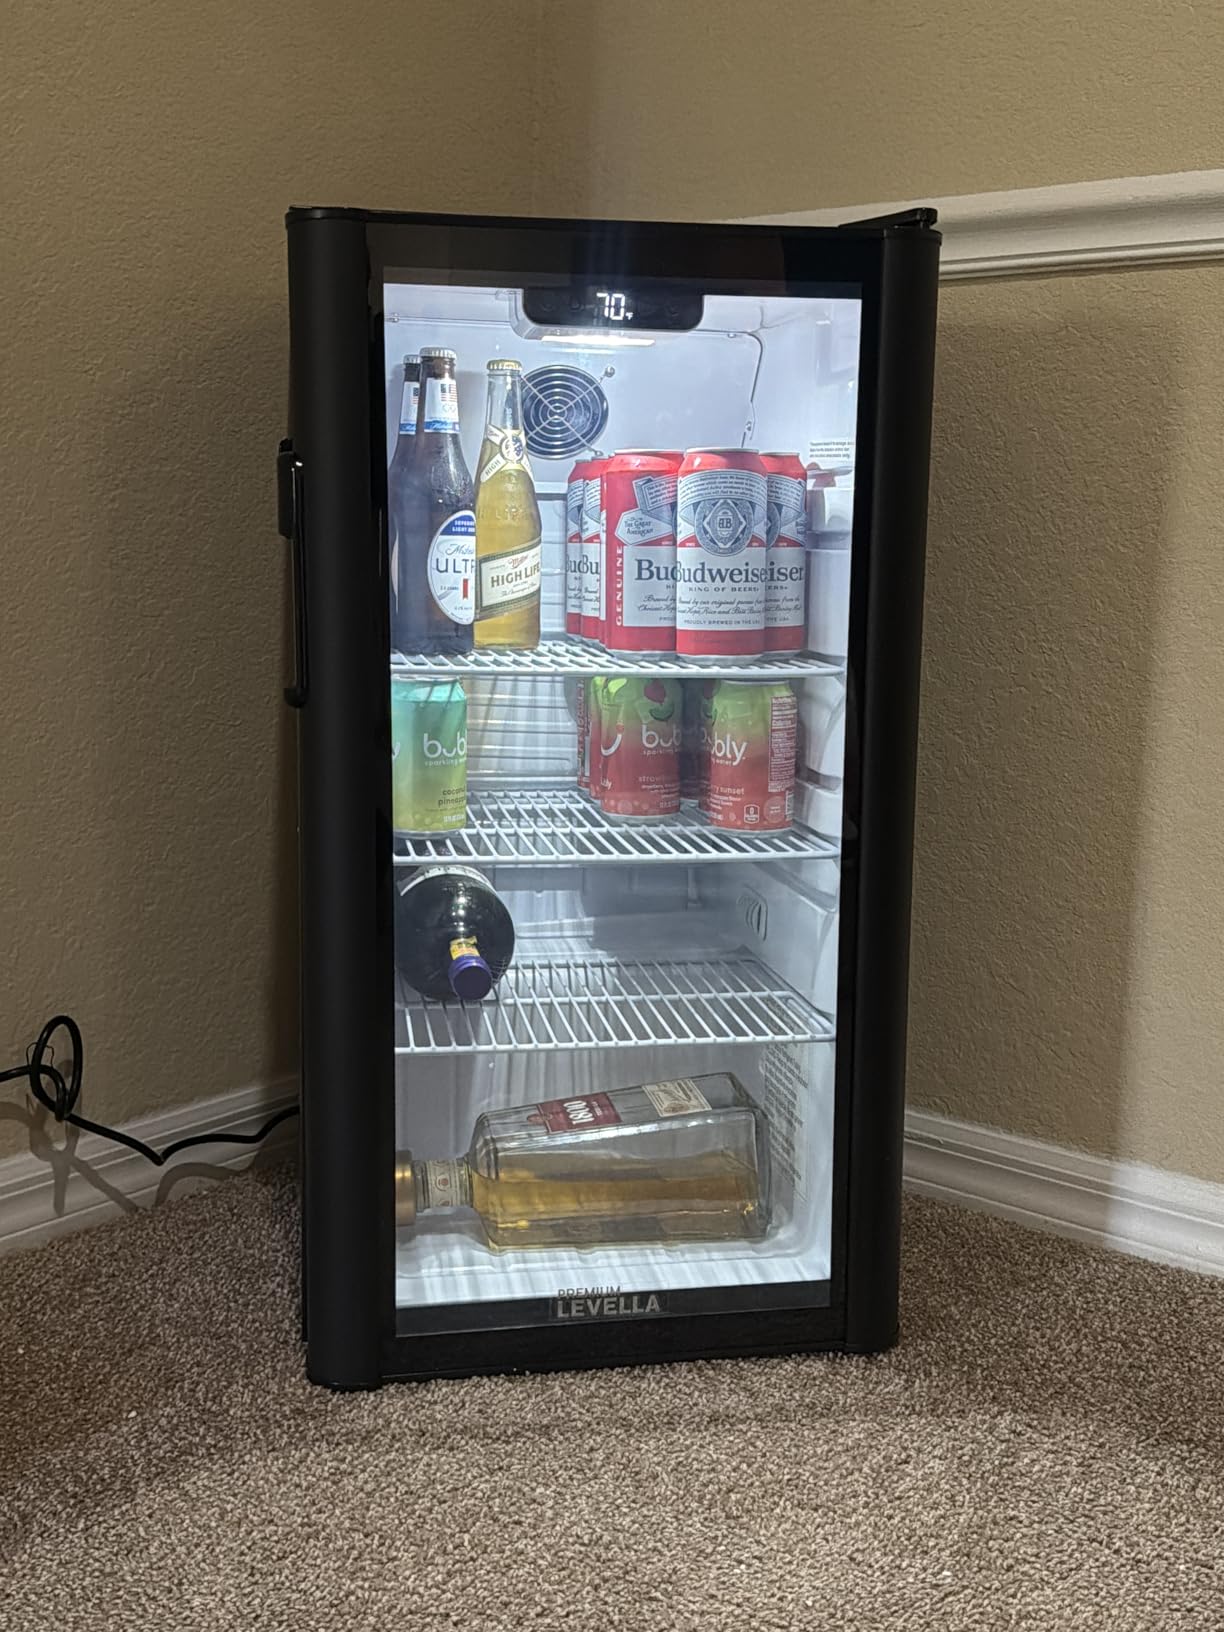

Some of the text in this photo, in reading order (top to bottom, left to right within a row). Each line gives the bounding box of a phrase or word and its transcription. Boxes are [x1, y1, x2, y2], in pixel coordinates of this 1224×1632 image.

[596, 293, 625, 320] 70
[485, 459, 502, 476] HIGH
[490, 570, 523, 588] HIGH
[524, 561, 541, 579] LIFE
[720, 786, 745, 796] sunset
[563, 1099, 595, 1126] 1800
[558, 1285, 621, 1299] PREMIUM
[557, 1294, 661, 1318] LEVELLA
